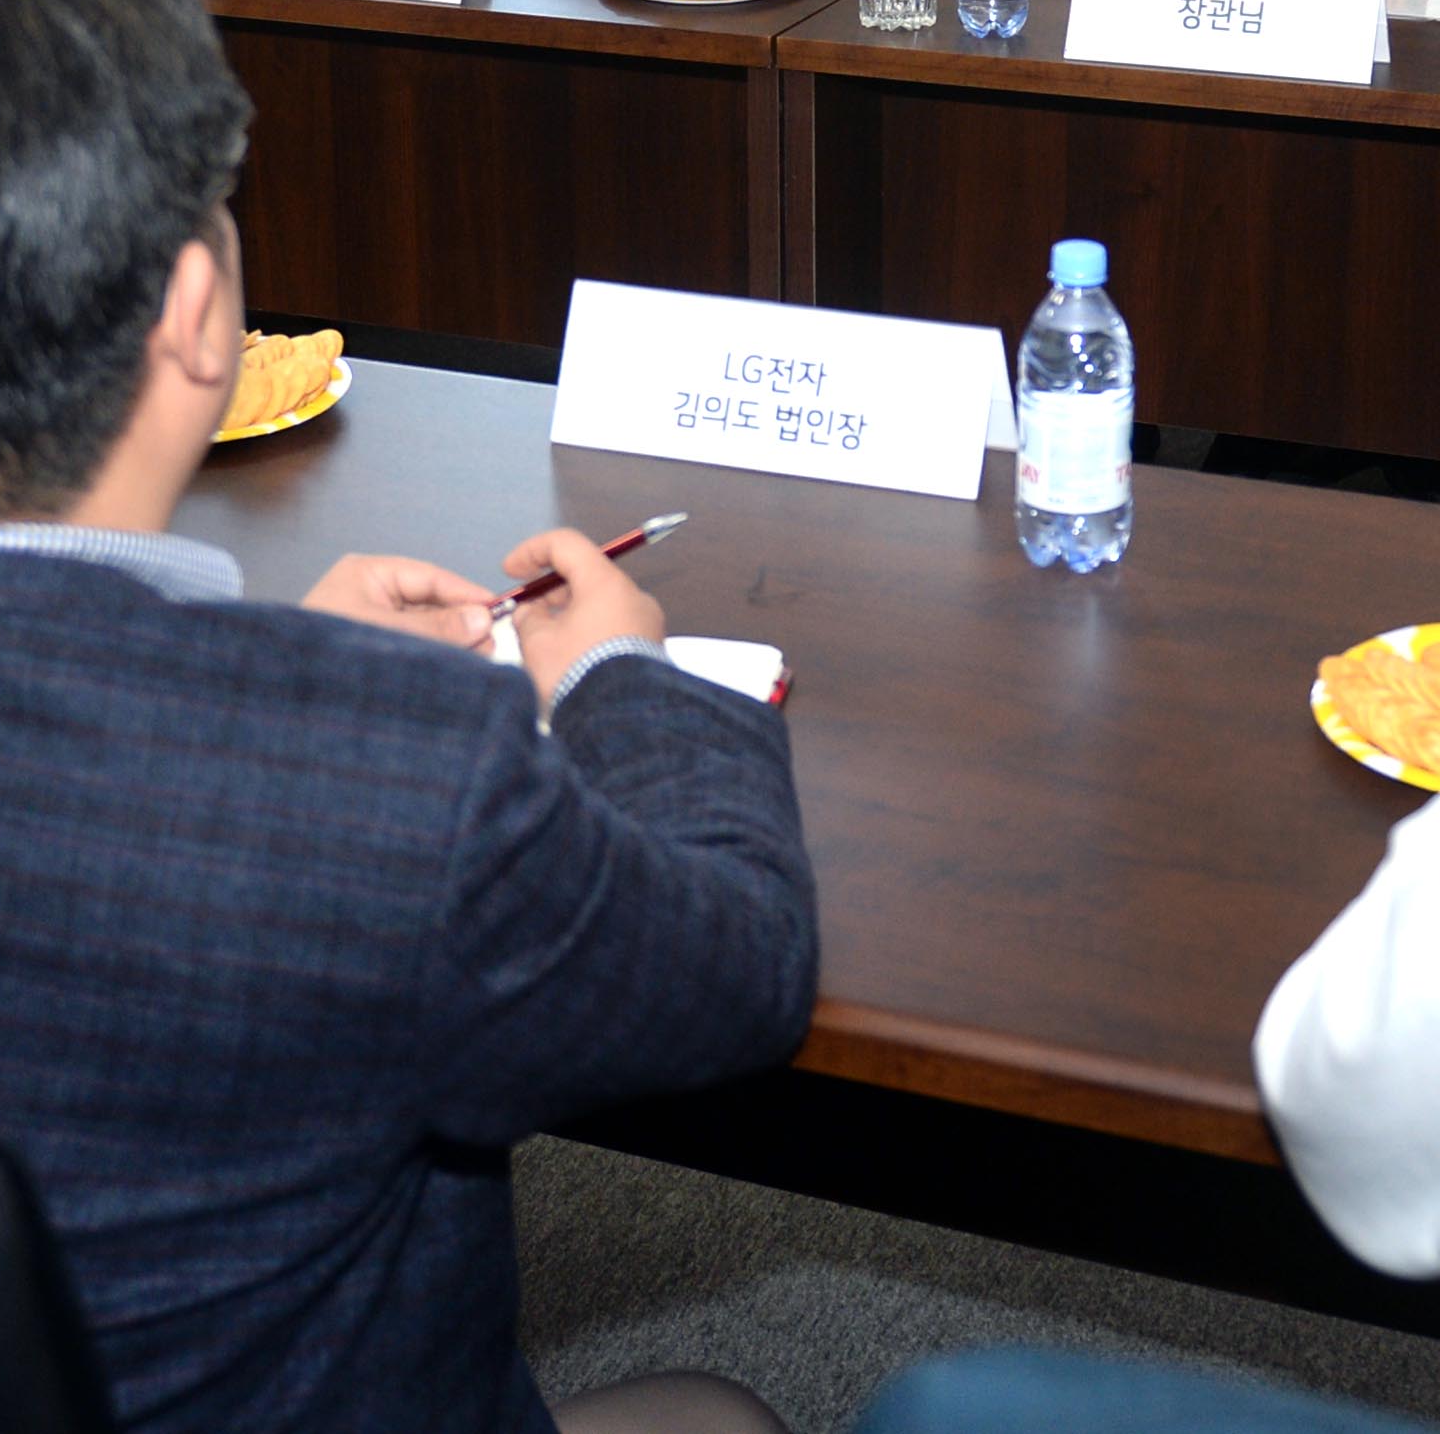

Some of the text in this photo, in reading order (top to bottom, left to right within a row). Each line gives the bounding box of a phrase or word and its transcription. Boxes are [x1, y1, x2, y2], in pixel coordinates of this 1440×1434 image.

[724, 352, 826, 396] LG전자
[674, 391, 867, 451] 김의도 법인장
